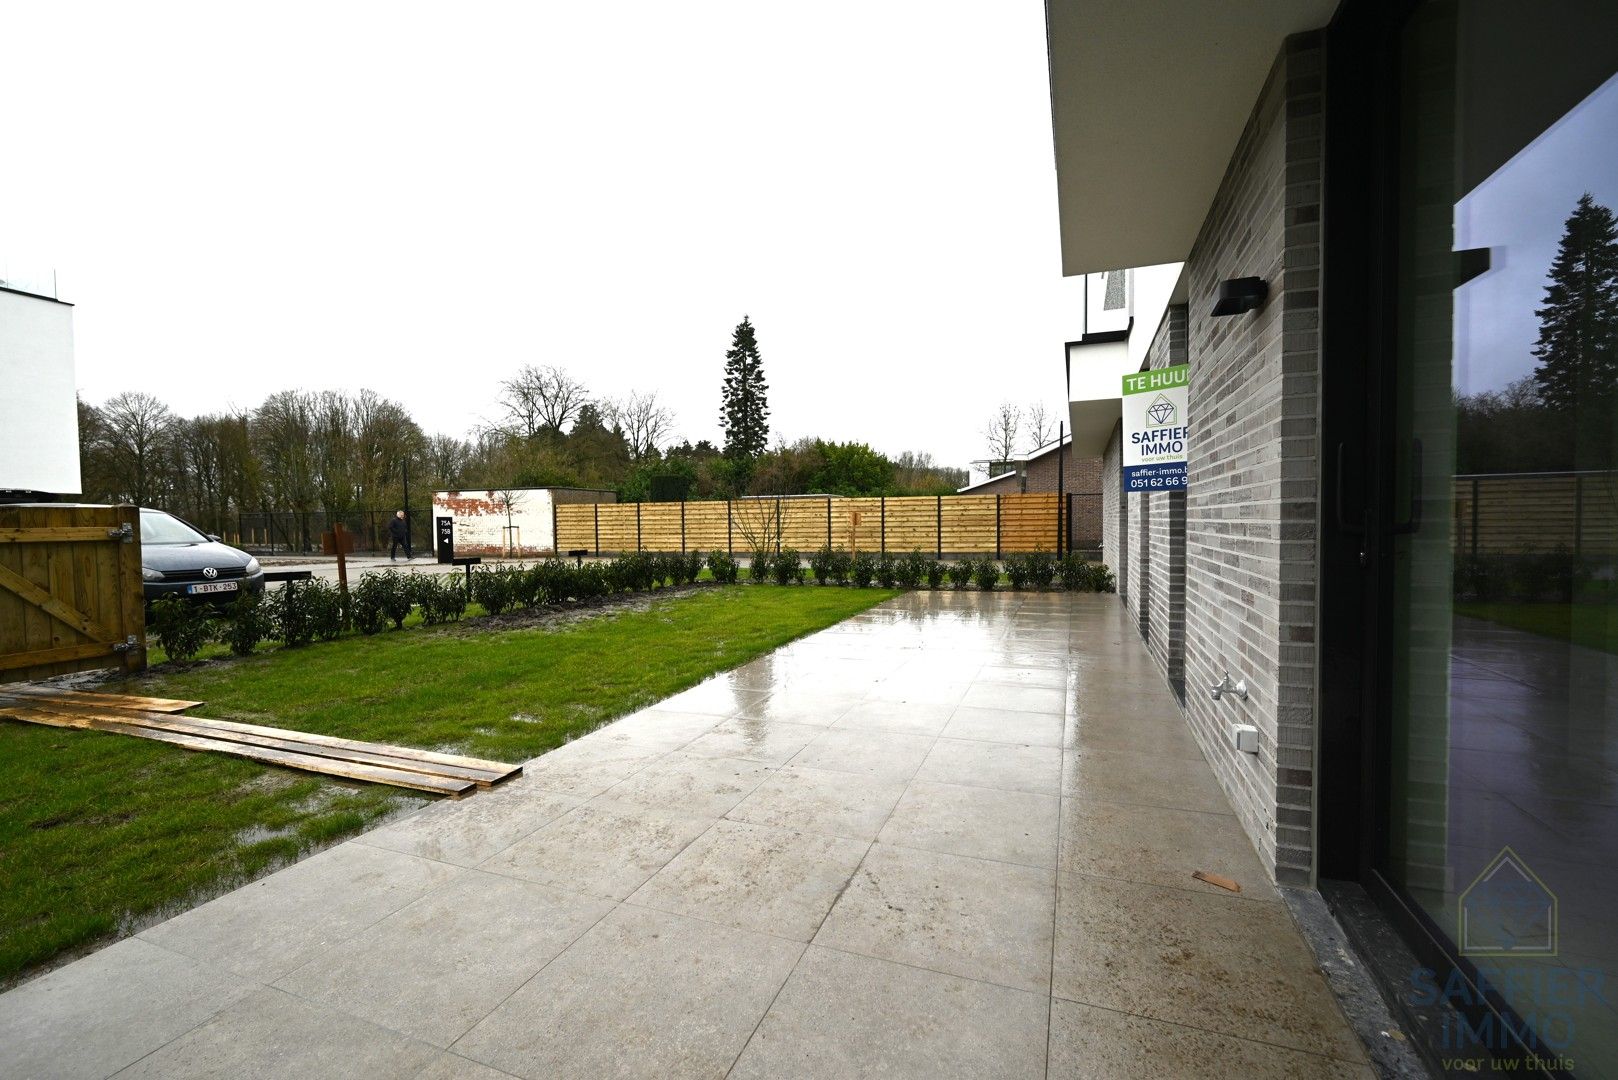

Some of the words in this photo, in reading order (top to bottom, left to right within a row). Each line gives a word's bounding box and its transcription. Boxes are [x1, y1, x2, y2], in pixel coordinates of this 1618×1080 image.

[1126, 376, 1147, 391] TE
[1150, 369, 1189, 388] HUU
[1141, 440, 1183, 456] IMMO
[1130, 479, 1148, 488] 051
[1150, 477, 1163, 487] 62
[1165, 476, 1179, 486] 66
